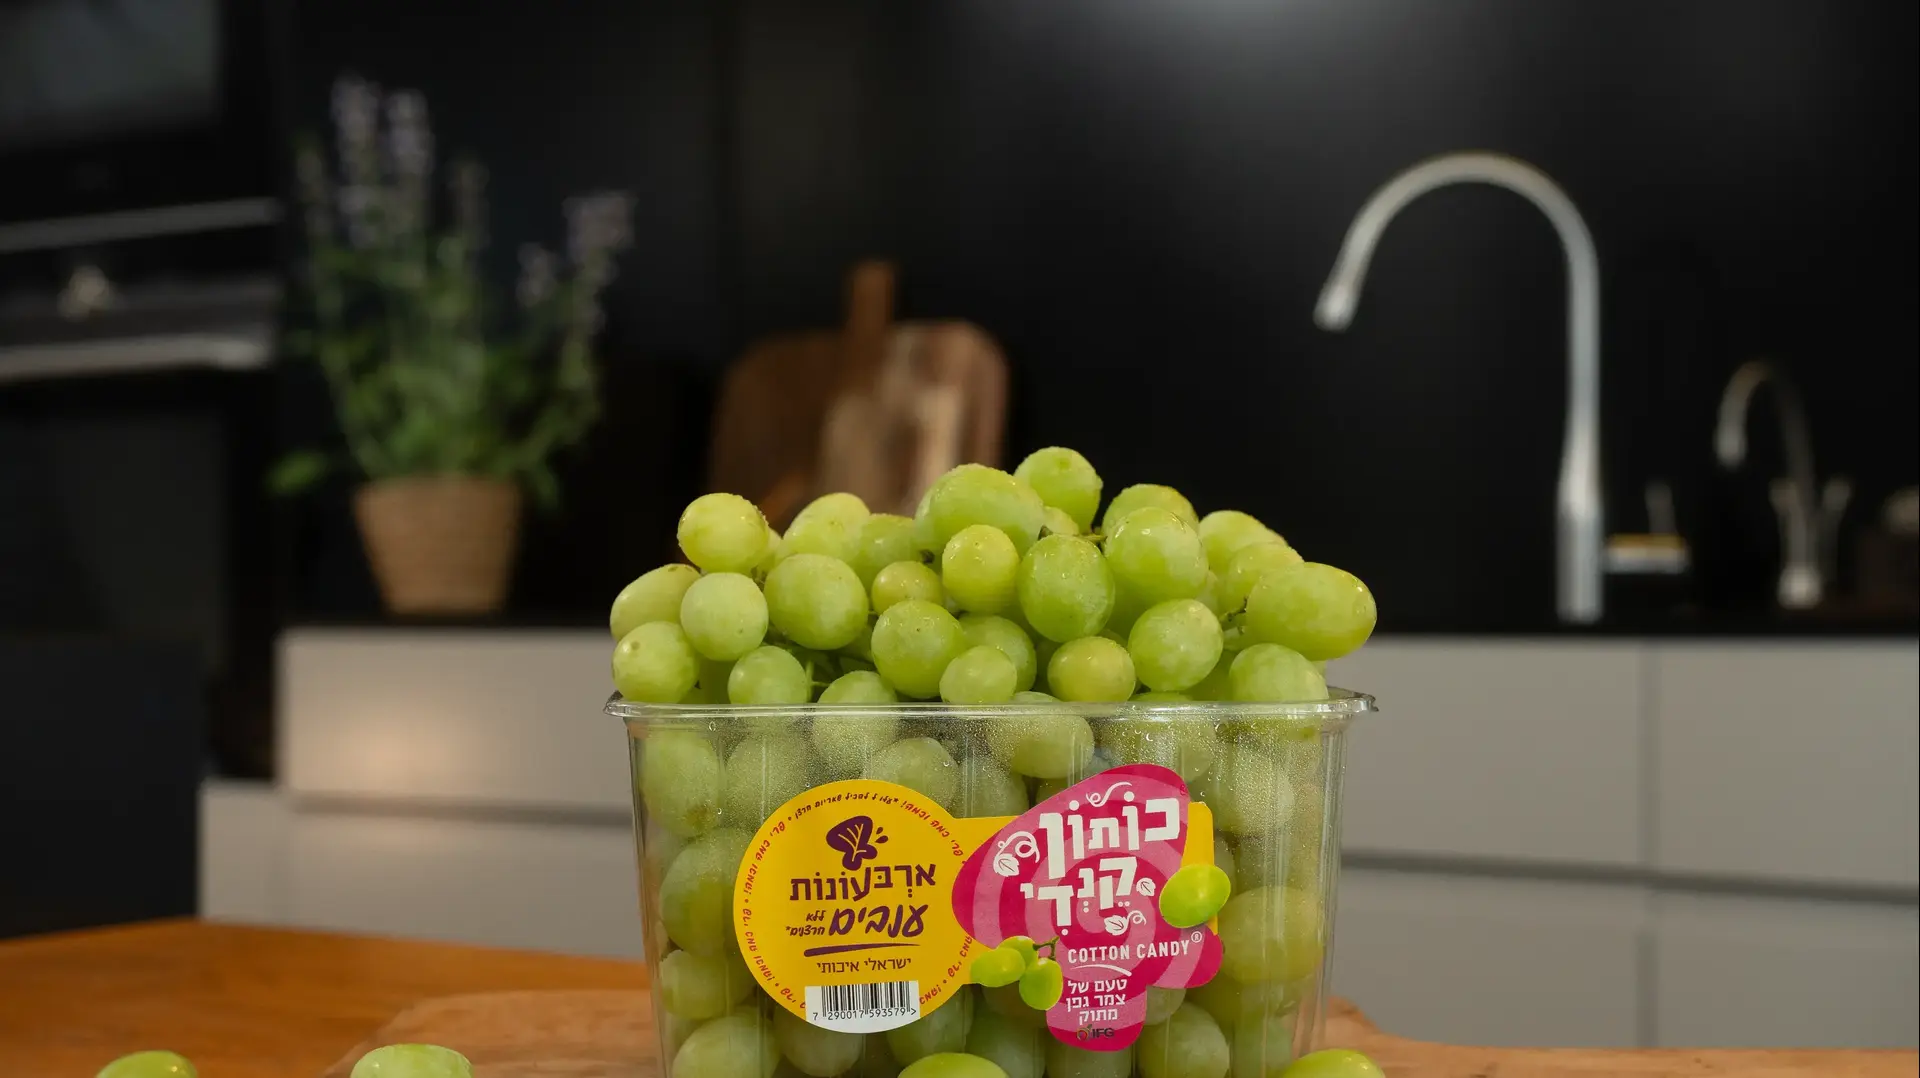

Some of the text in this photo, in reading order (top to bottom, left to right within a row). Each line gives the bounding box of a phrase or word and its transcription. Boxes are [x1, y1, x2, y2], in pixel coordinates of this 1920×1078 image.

[769, 821, 786, 837] פרי
[930, 820, 950, 838] כמה
[755, 839, 771, 861] כמה
[949, 839, 964, 856] פרי
[806, 910, 827, 921] ללא
[828, 904, 929, 938] ענבים
[1067, 944, 1131, 964] COTTON
[816, 957, 912, 973] ישראלי איכותי
[919, 984, 942, 1005] כמה!
[1067, 979, 1128, 994] טעם של
[1065, 994, 1127, 1012] צמר גפן
[812, 1012, 819, 1021] 7
[827, 1009, 865, 1021] 290017
[869, 1007, 907, 1019] 593579
[1079, 1008, 1118, 1026] מתוק
[1092, 1027, 1115, 1038] IFG
